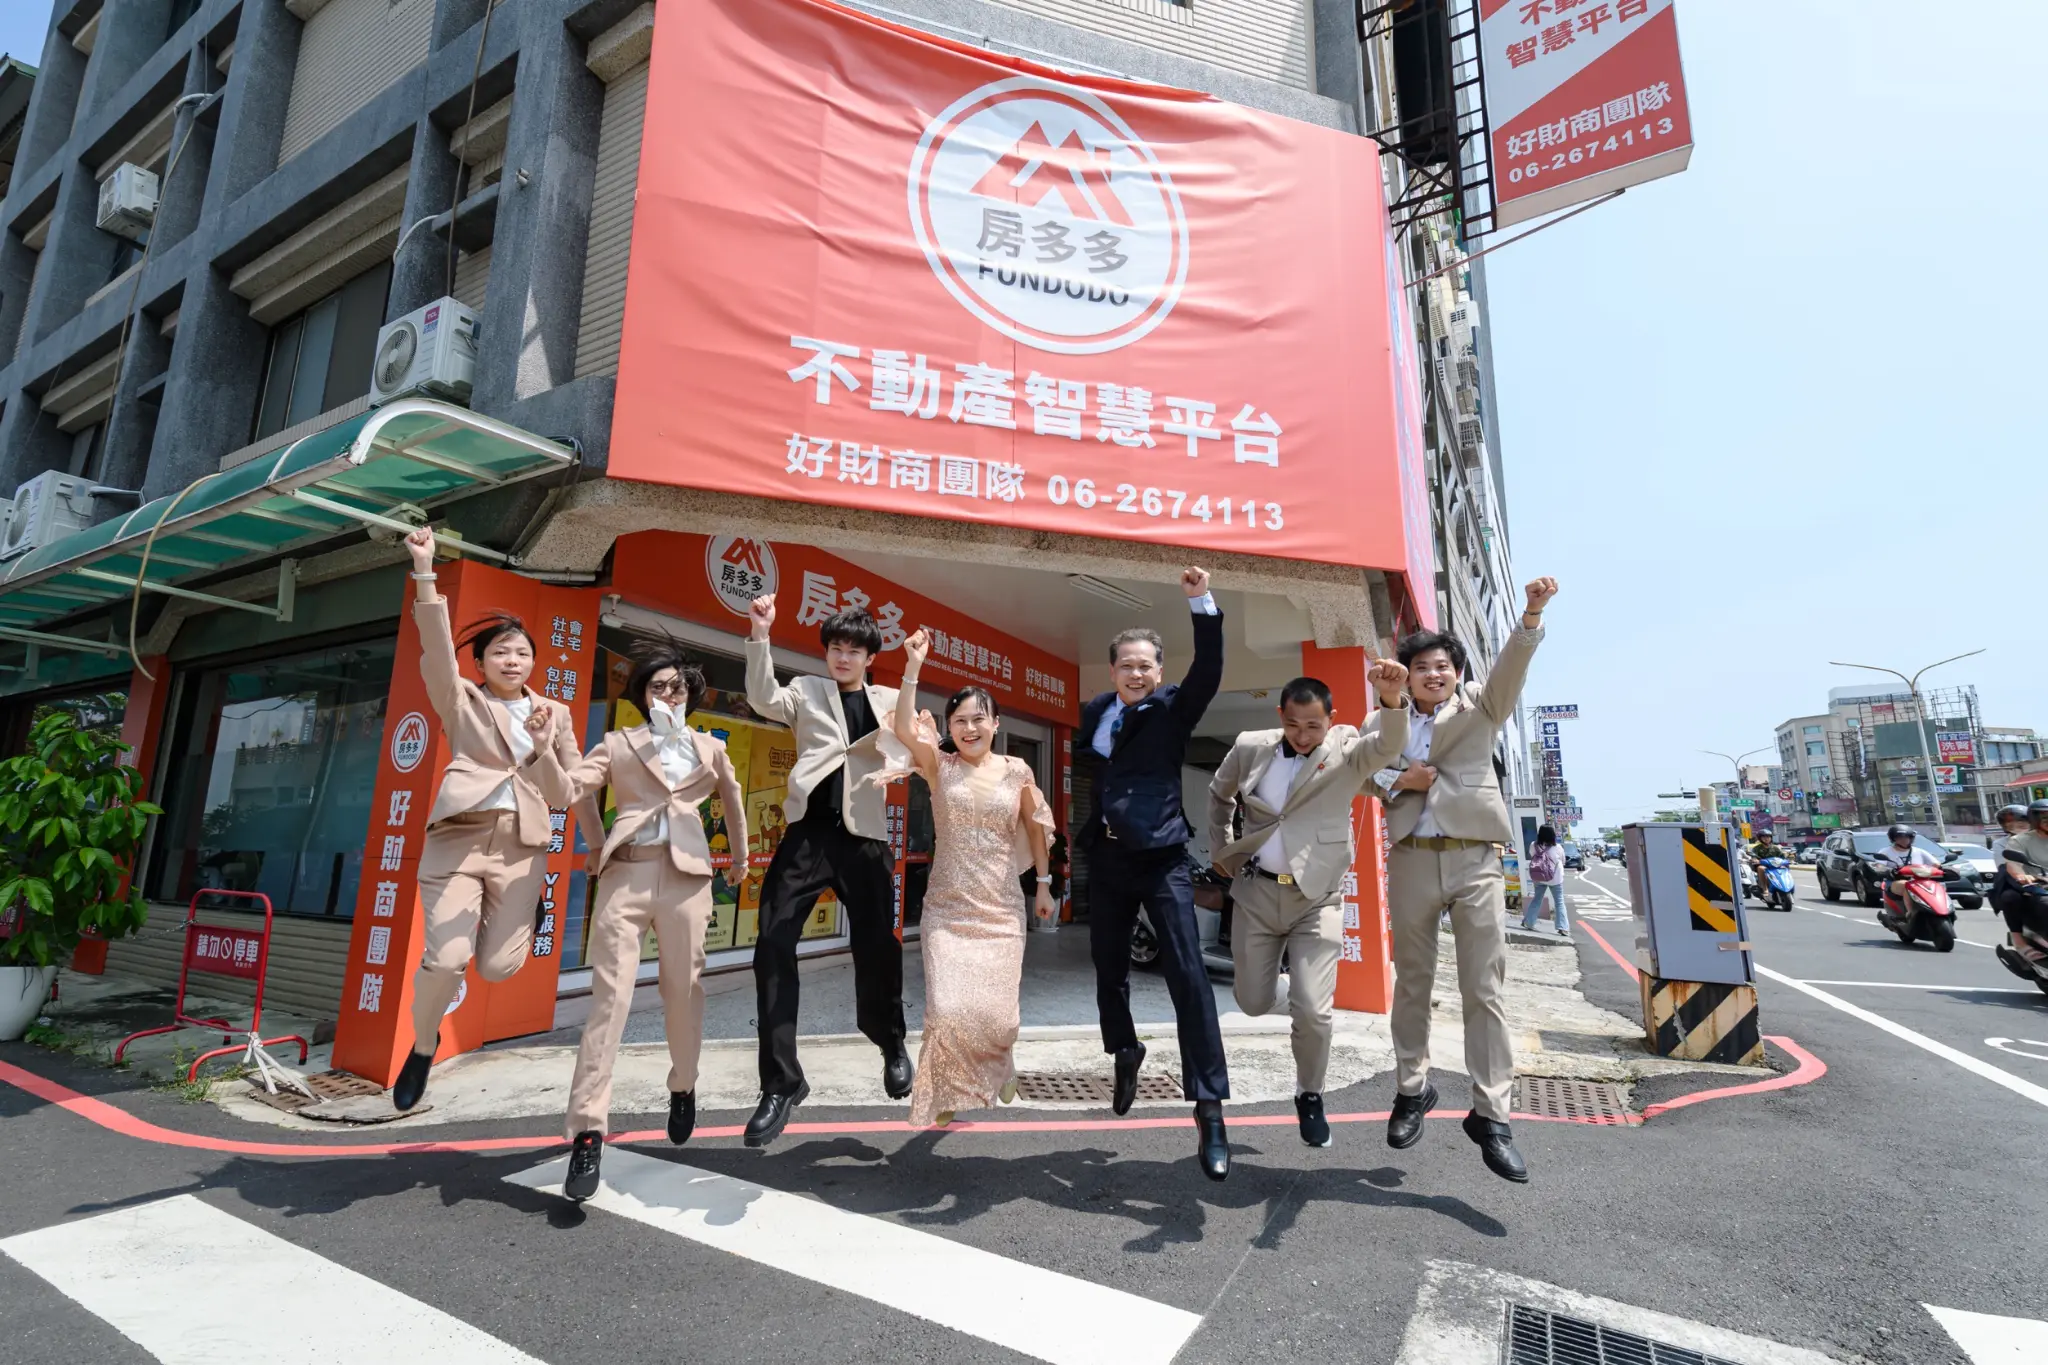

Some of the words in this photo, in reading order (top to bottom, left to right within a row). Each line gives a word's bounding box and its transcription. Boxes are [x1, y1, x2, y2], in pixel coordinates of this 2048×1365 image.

[1506, 81, 1672, 159] 好財商團隊
[1508, 117, 1674, 183] 06-2674113
[976, 206, 1131, 274] 房多多
[977, 260, 1131, 307] FUNDODO
[786, 335, 1283, 468] 不動產智慧平台
[785, 432, 1026, 503] 好財商團隊
[1047, 474, 1285, 530] 06-2674113
[721, 564, 763, 592] 房多多
[1025, 686, 1066, 709] 06-2674113
[398, 742, 419, 754] 房多多
[358, 790, 412, 1013] 好財商團隊
[233, 938, 259, 962] 停車
